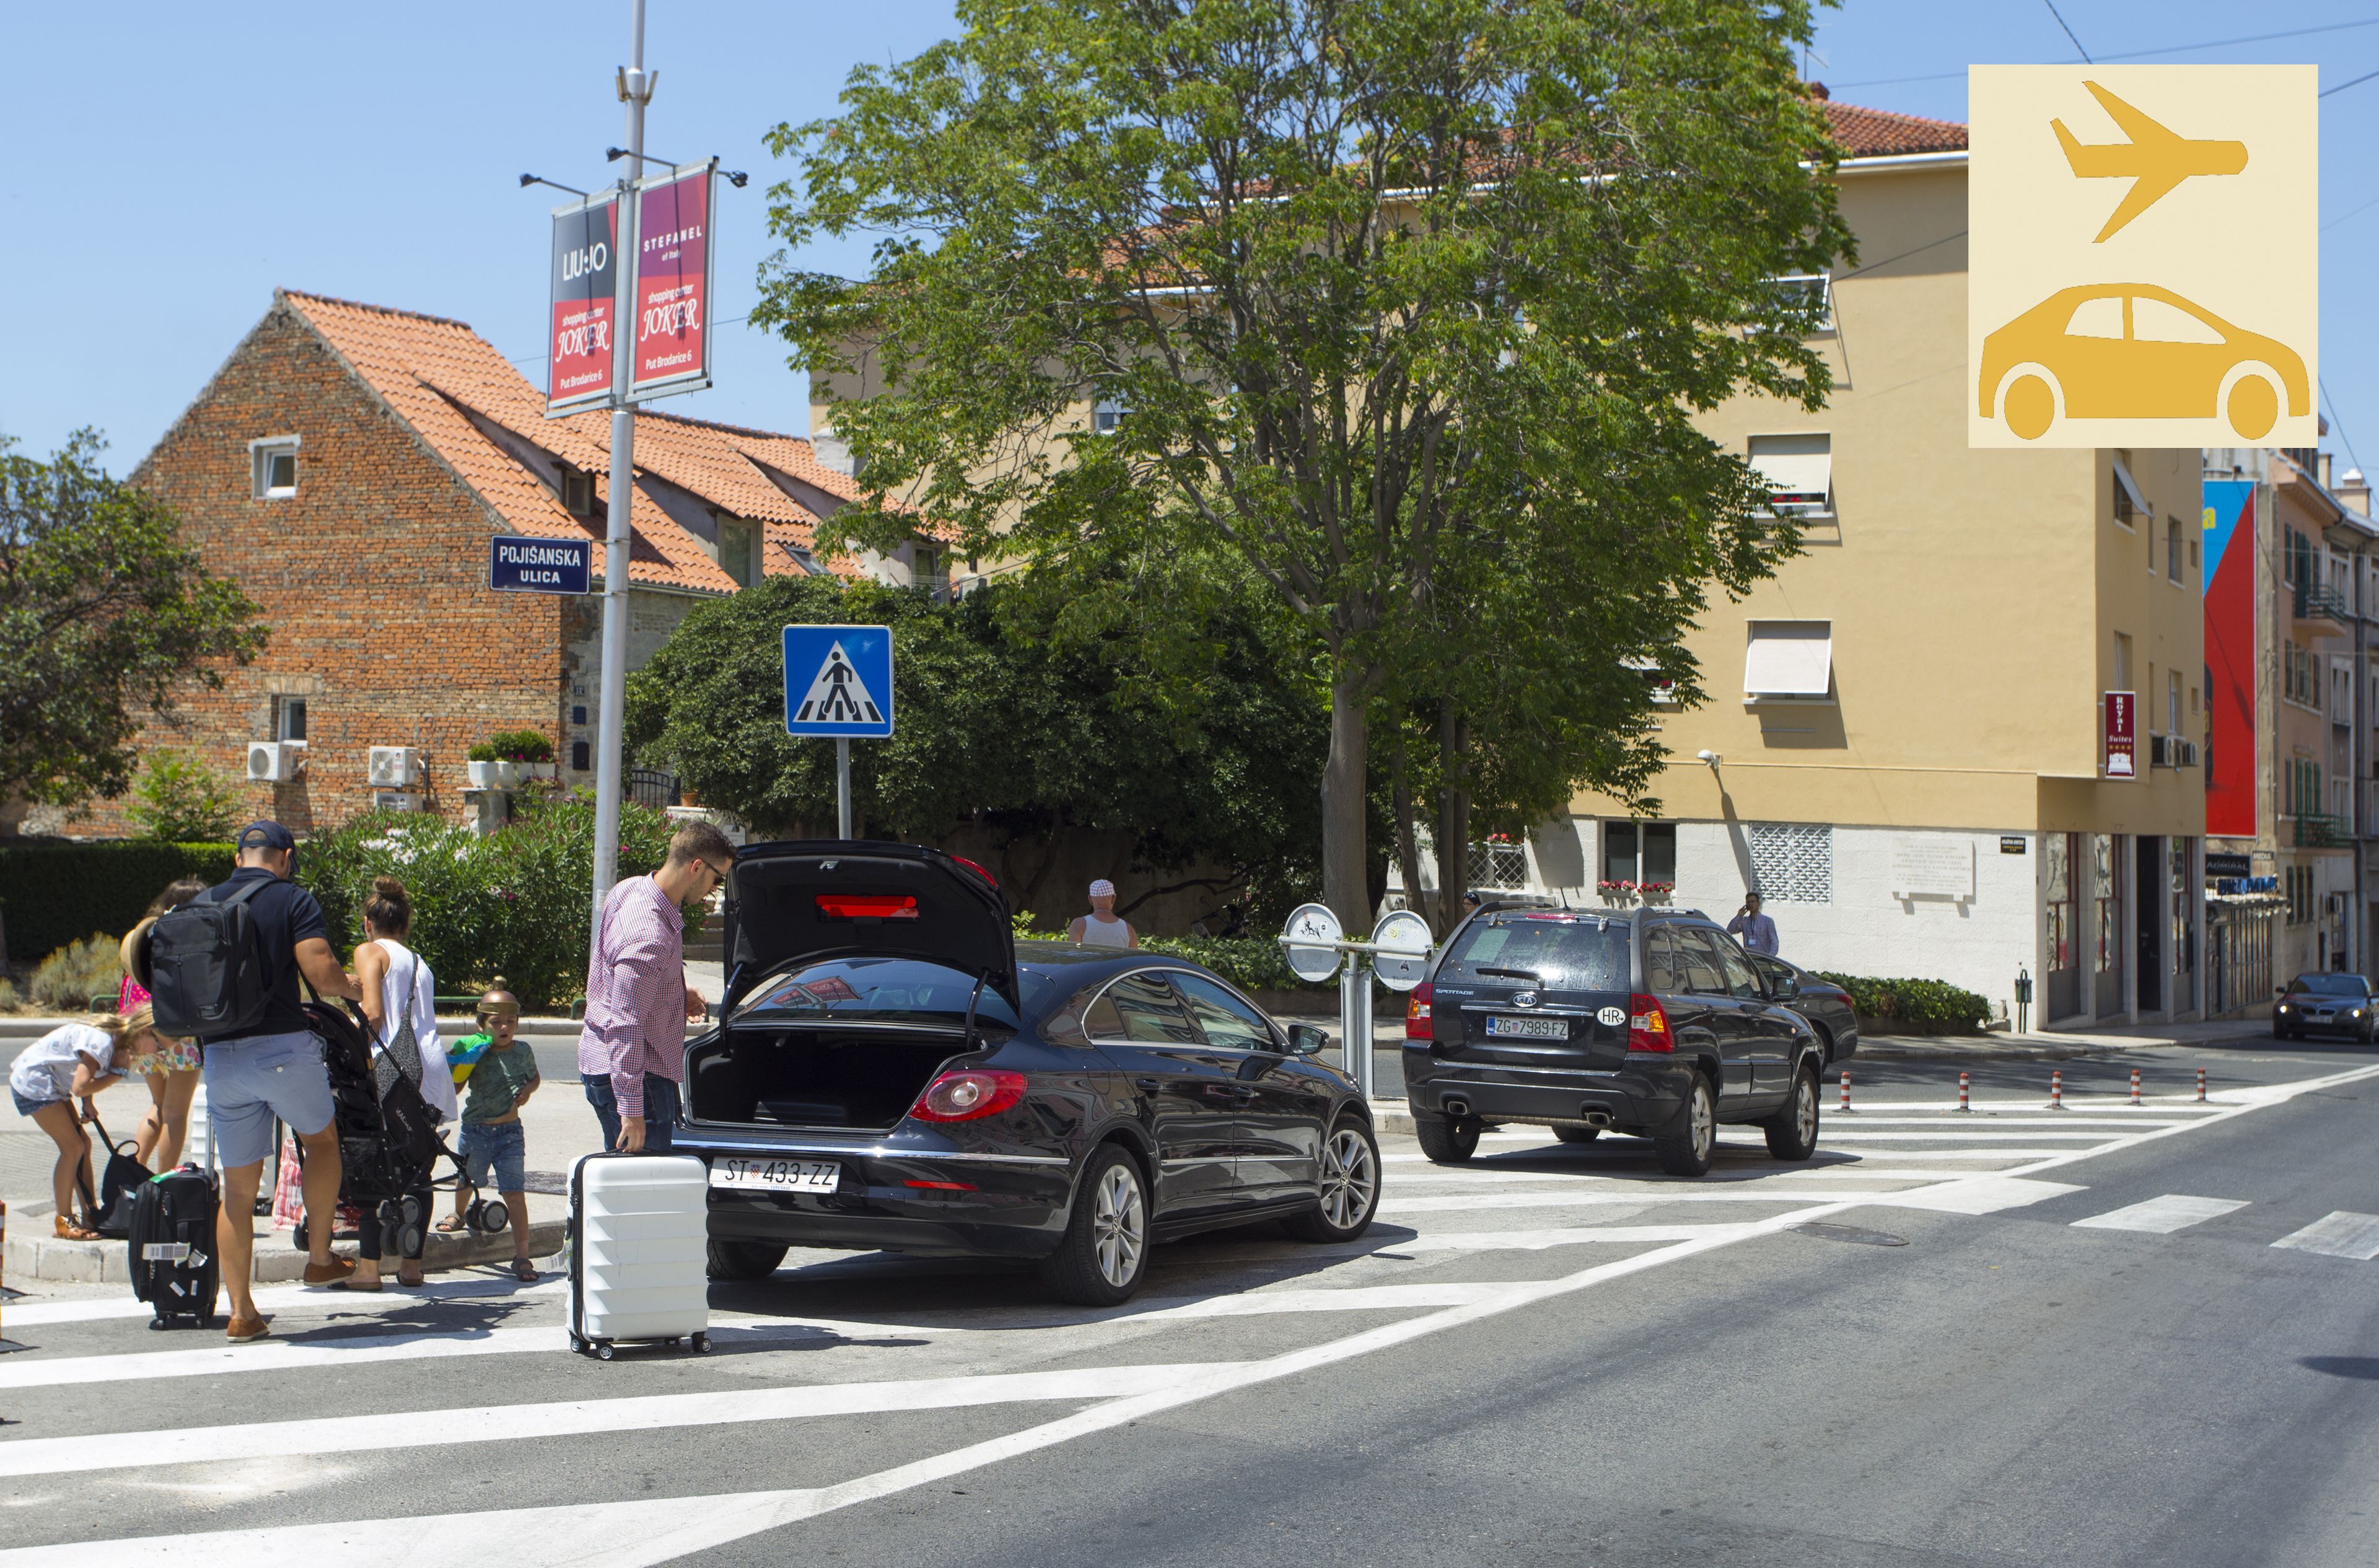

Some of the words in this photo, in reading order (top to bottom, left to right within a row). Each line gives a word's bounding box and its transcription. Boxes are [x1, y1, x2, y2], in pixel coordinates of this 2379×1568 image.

[644, 226, 702, 253] STEFANEL
[648, 289, 675, 304] shopping
[675, 284, 694, 298] center
[563, 311, 587, 327] shopping
[640, 298, 699, 342] JOKER
[555, 320, 610, 362] JOKER
[646, 358, 657, 370] Put
[657, 351, 686, 369] Brodarice
[687, 349, 693, 361] 6
[560, 378, 571, 390] Put
[571, 372, 598, 387] Brodarice
[598, 369, 603, 380] 6
[499, 545, 581, 567] POJIŠANSKA
[520, 570, 561, 584] ULICA
[2116, 696, 2124, 733] Royal
[2108, 735, 2132, 743] Suites
[2206, 859, 2249, 871] ADMIRAL
[2252, 852, 2272, 861] MEDIA
[1496, 1019, 1511, 1033] ZG
[1603, 1009, 1619, 1023] HR
[725, 1159, 750, 1181] ST
[763, 1162, 836, 1186] 433-ZZ
